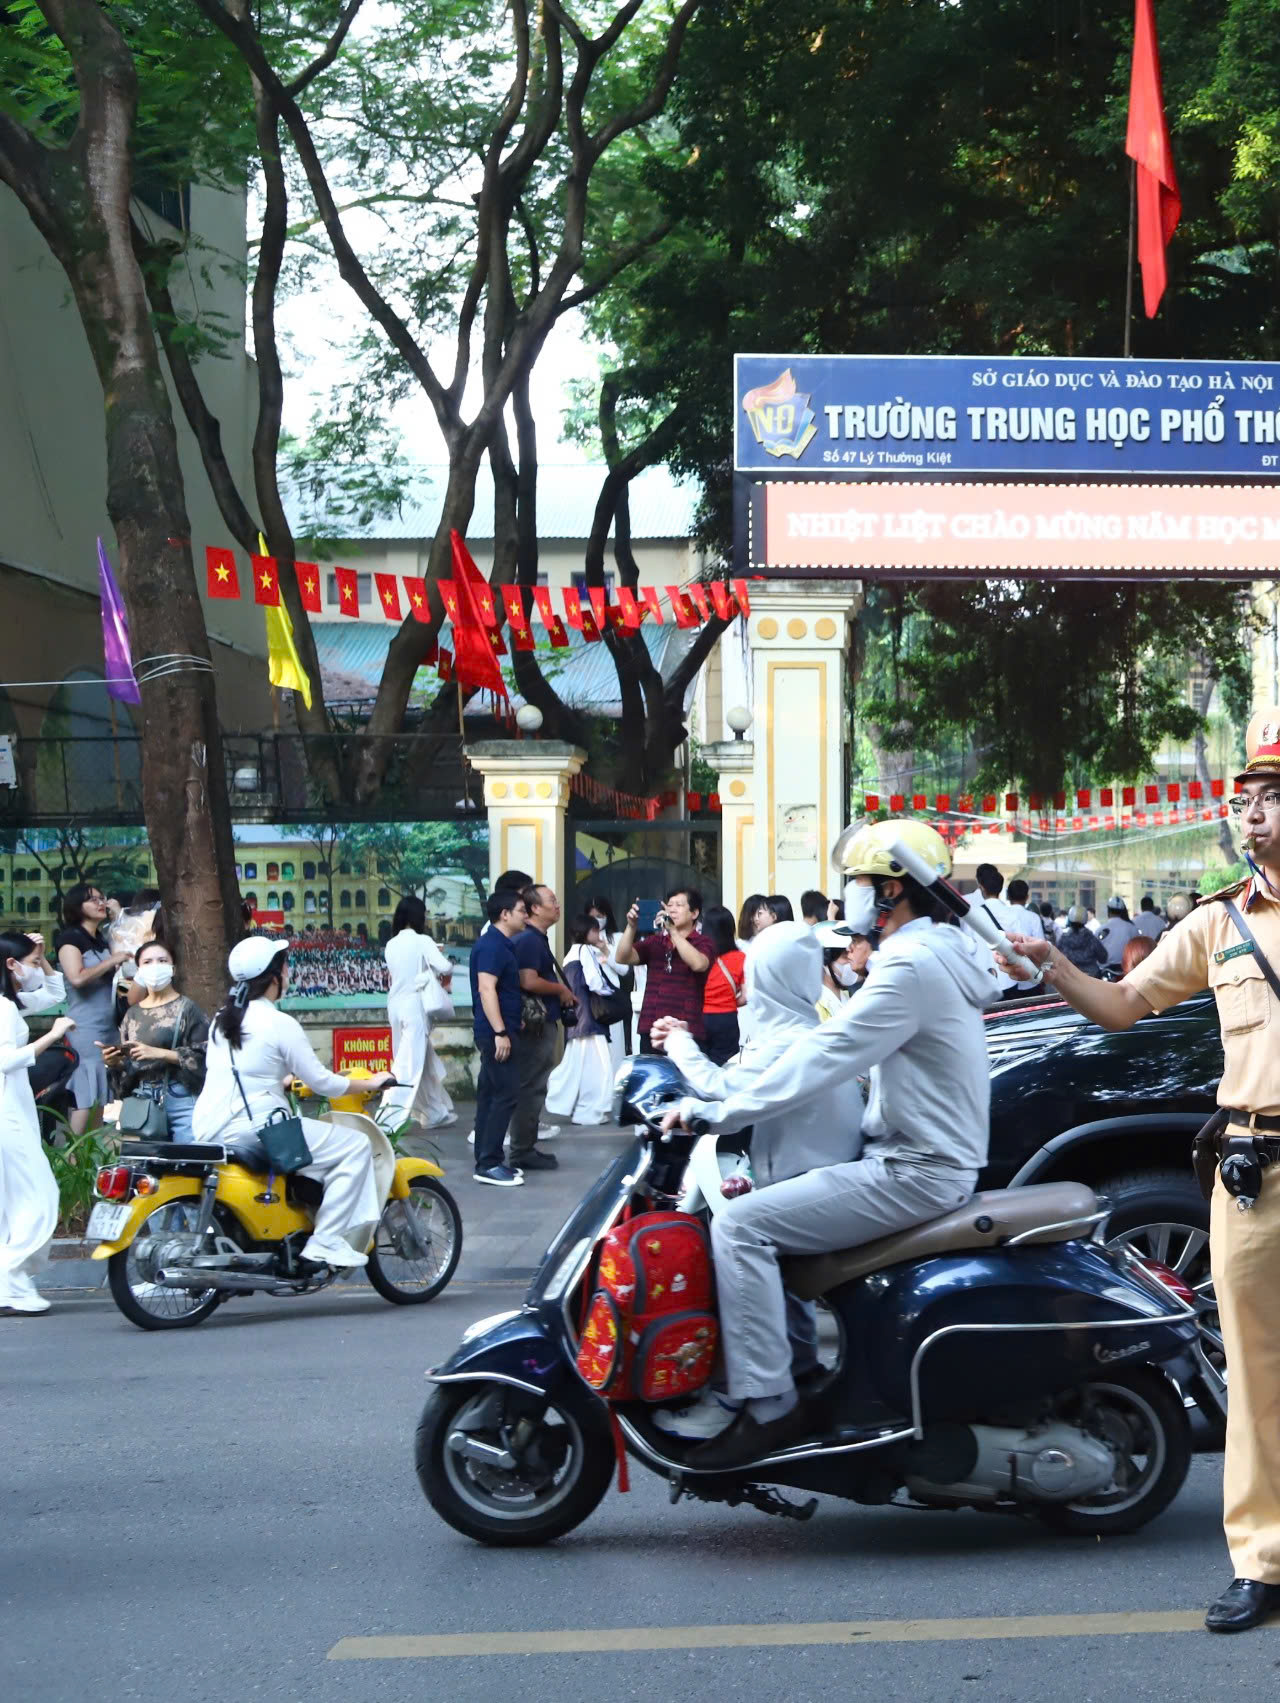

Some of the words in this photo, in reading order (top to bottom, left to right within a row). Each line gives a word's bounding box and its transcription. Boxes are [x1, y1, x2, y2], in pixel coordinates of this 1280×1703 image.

[972, 368, 997, 387] SỞ
[1002, 369, 1050, 387] GIÁO
[1055, 373, 1093, 391] DỤC
[1099, 370, 1120, 387] VÀ
[1126, 370, 1162, 388] ĐÀO
[1167, 375, 1202, 392] TẠO
[1208, 371, 1235, 389] HÀ
[1241, 374, 1273, 394] NỘI
[824, 396, 957, 441] TRƯỜNG
[966, 407, 1076, 441] TRUNG
[1086, 408, 1150, 448] HỌC
[1160, 394, 1225, 442] PHỔ
[823, 449, 840, 463] Số
[842, 451, 857, 463] 47
[860, 452, 874, 466] Lý
[877, 452, 923, 466] Thường
[927, 452, 952, 466] Kiệt
[1261, 456, 1279, 466] ĐT
[786, 509, 879, 543] NHIỆT
[883, 509, 947, 543] LIỆT
[950, 509, 1030, 540] CHÀO
[1035, 510, 1122, 540] MỪNG
[1127, 511, 1192, 540] NĂM
[1196, 516, 1256, 544] HỌC
[344, 1037, 375, 1052] KHÔNG
[378, 1035, 390, 1051] ĐỂ
